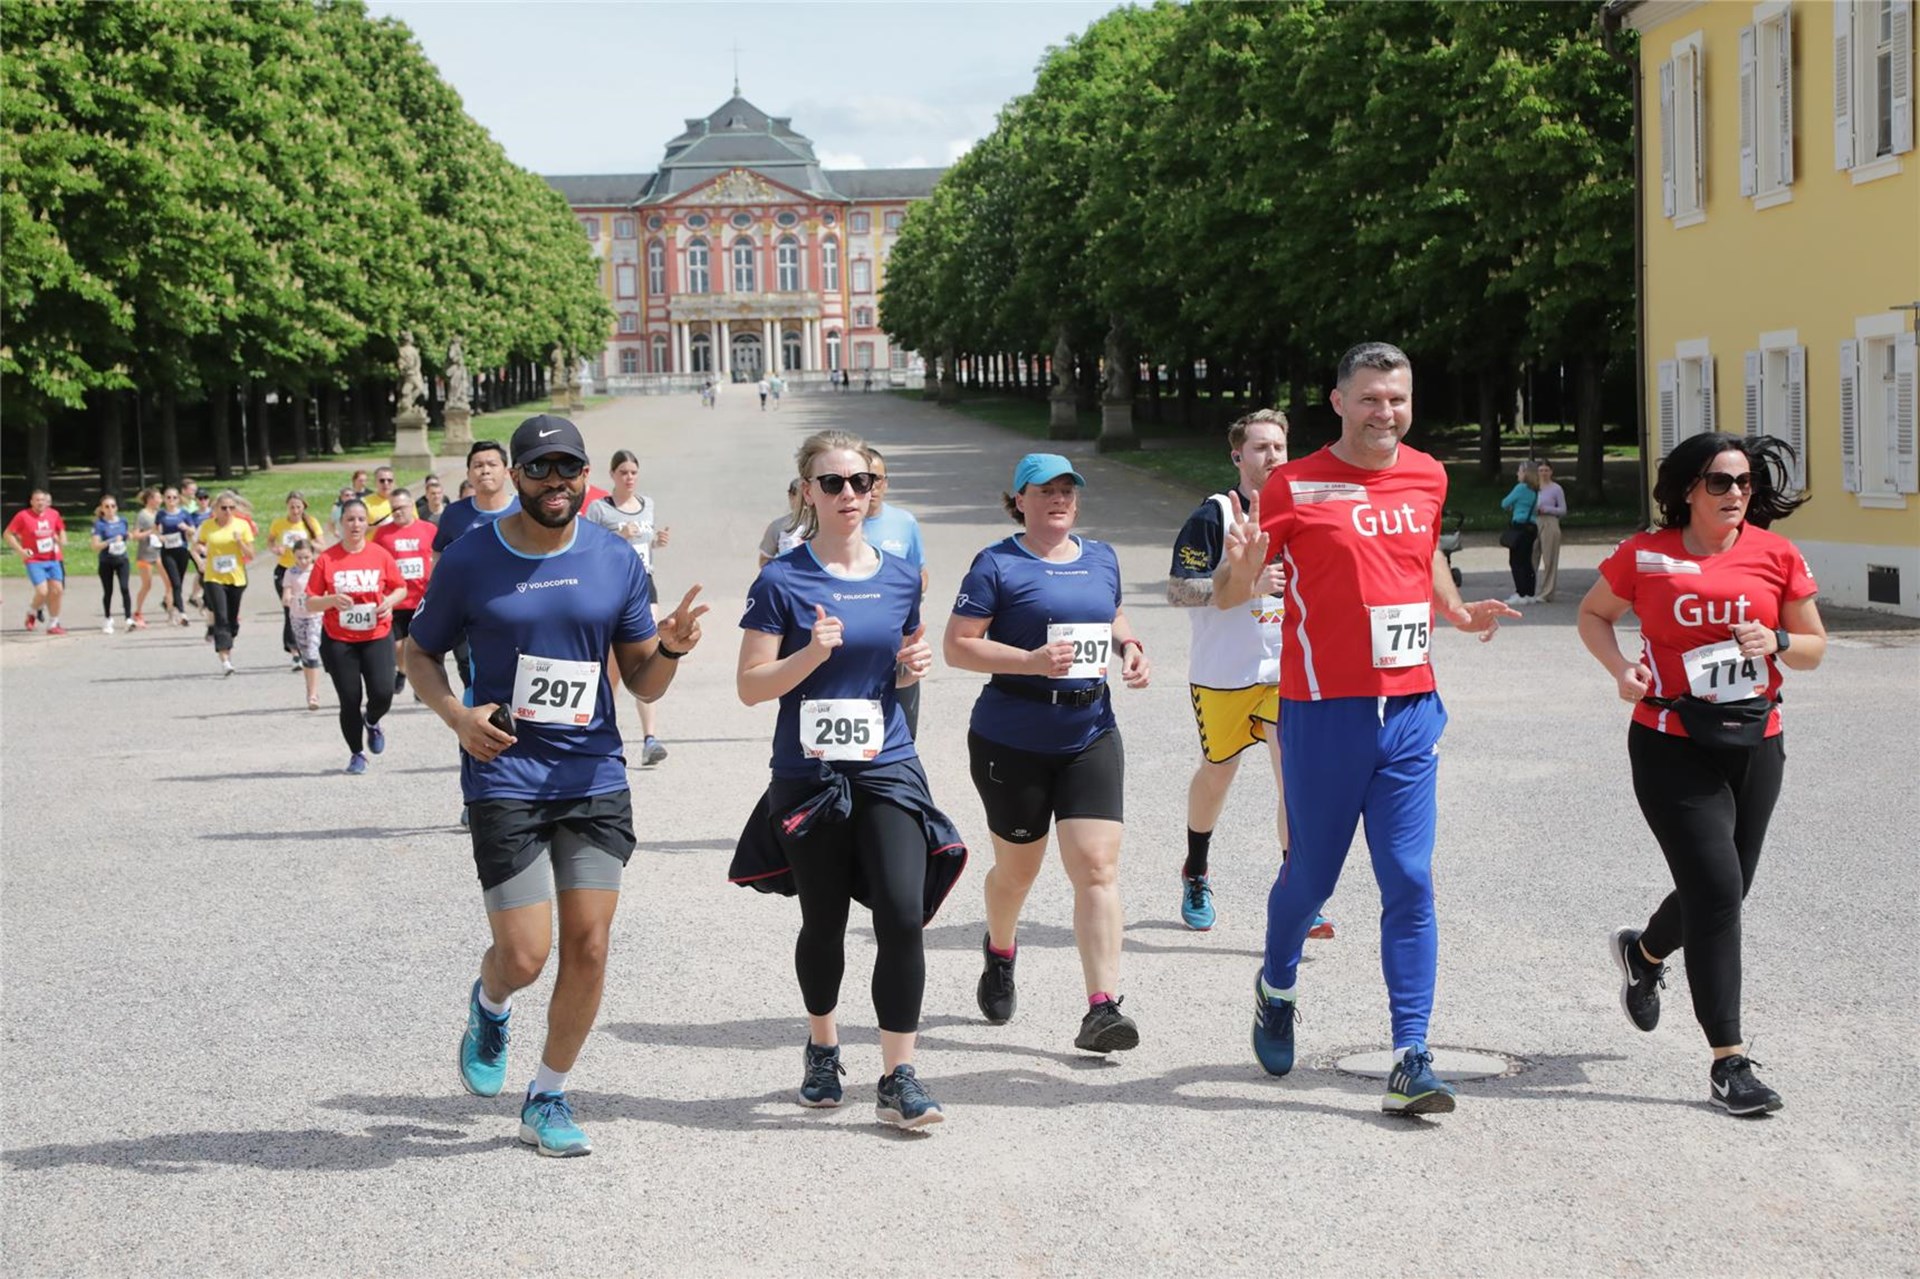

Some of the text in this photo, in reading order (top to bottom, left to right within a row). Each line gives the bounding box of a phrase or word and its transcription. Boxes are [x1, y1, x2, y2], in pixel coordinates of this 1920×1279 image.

[1352, 503, 1427, 537] Gut.
[333, 569, 380, 587] SEW
[529, 578, 579, 590] VOLOCOPTER
[346, 612, 371, 625] 204
[1387, 621, 1427, 651] 775
[1702, 657, 1758, 689] 774
[527, 677, 588, 709] 297
[815, 717, 871, 745] 295
